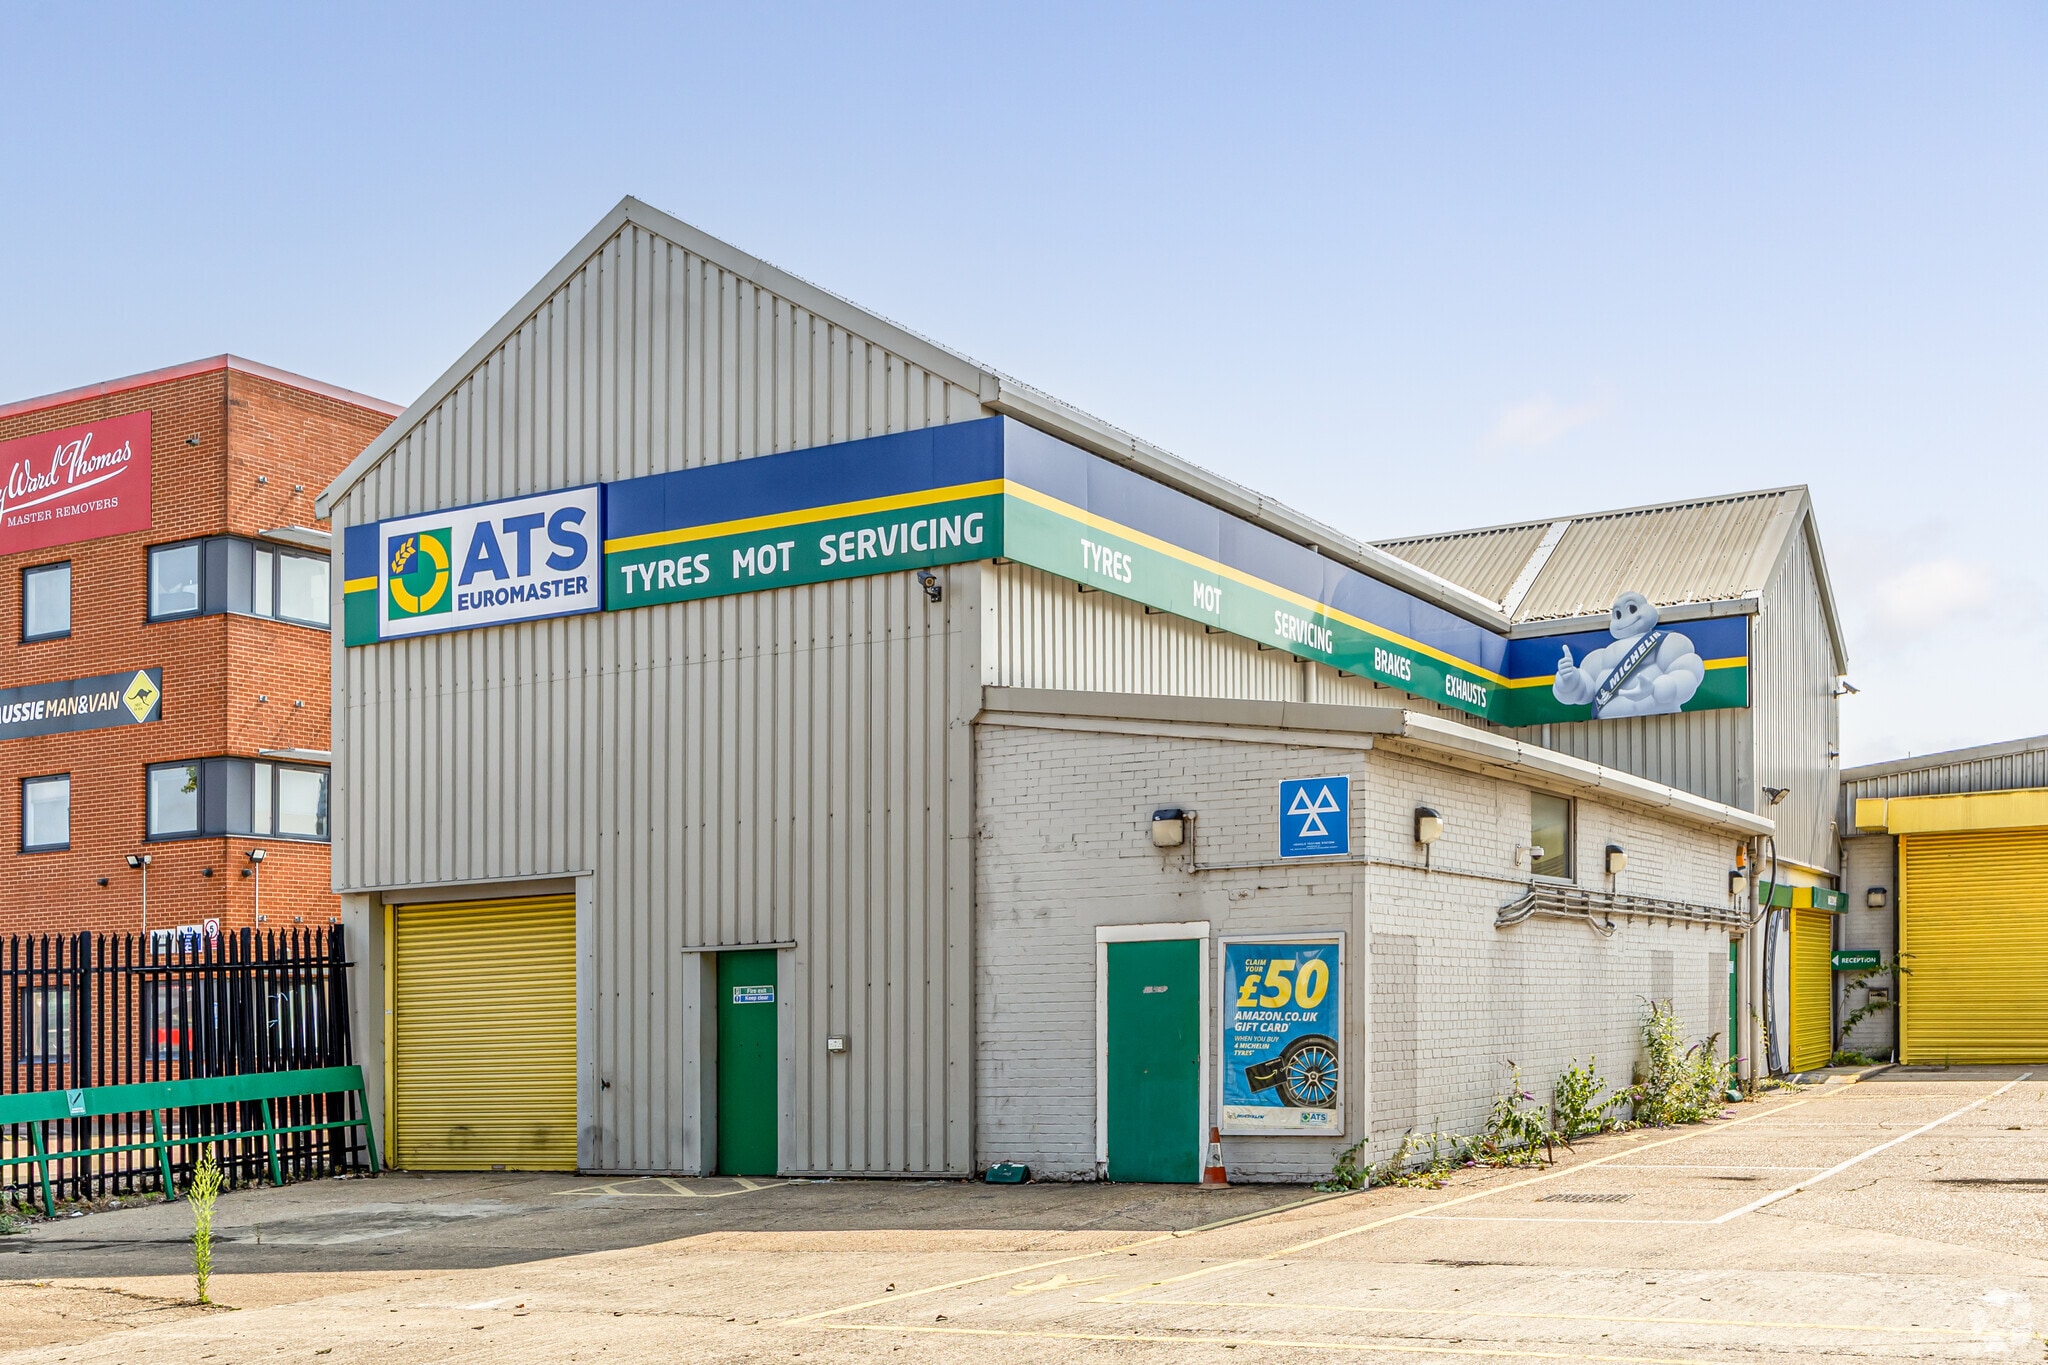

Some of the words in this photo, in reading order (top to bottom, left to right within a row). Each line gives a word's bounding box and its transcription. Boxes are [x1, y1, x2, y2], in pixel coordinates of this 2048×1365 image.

[7, 444, 60, 499] Ward
[59, 432, 132, 484] Thomas
[7, 510, 52, 527] MASTER
[55, 497, 119, 518] REMOVERS
[458, 506, 588, 587] ATS
[621, 553, 710, 594] TYRES
[732, 541, 795, 579] MOT
[819, 512, 984, 566] SERVICING
[458, 575, 588, 612] EUROMASTER
[1080, 538, 1132, 584] TYRES
[1193, 580, 1222, 615] MOT
[1274, 610, 1332, 654] SERVICING
[1374, 646, 1411, 682] BRAKES
[1445, 673, 1487, 708] EXHAUSTS
[1609, 631, 1662, 690] MICHELIN
[1236, 958, 1329, 1009] £50
[1234, 1011, 1318, 1022] AMAZON.CO.UK
[1234, 1022, 1258, 1032] GIFT
[1310, 1113, 1326, 1121] ATS
